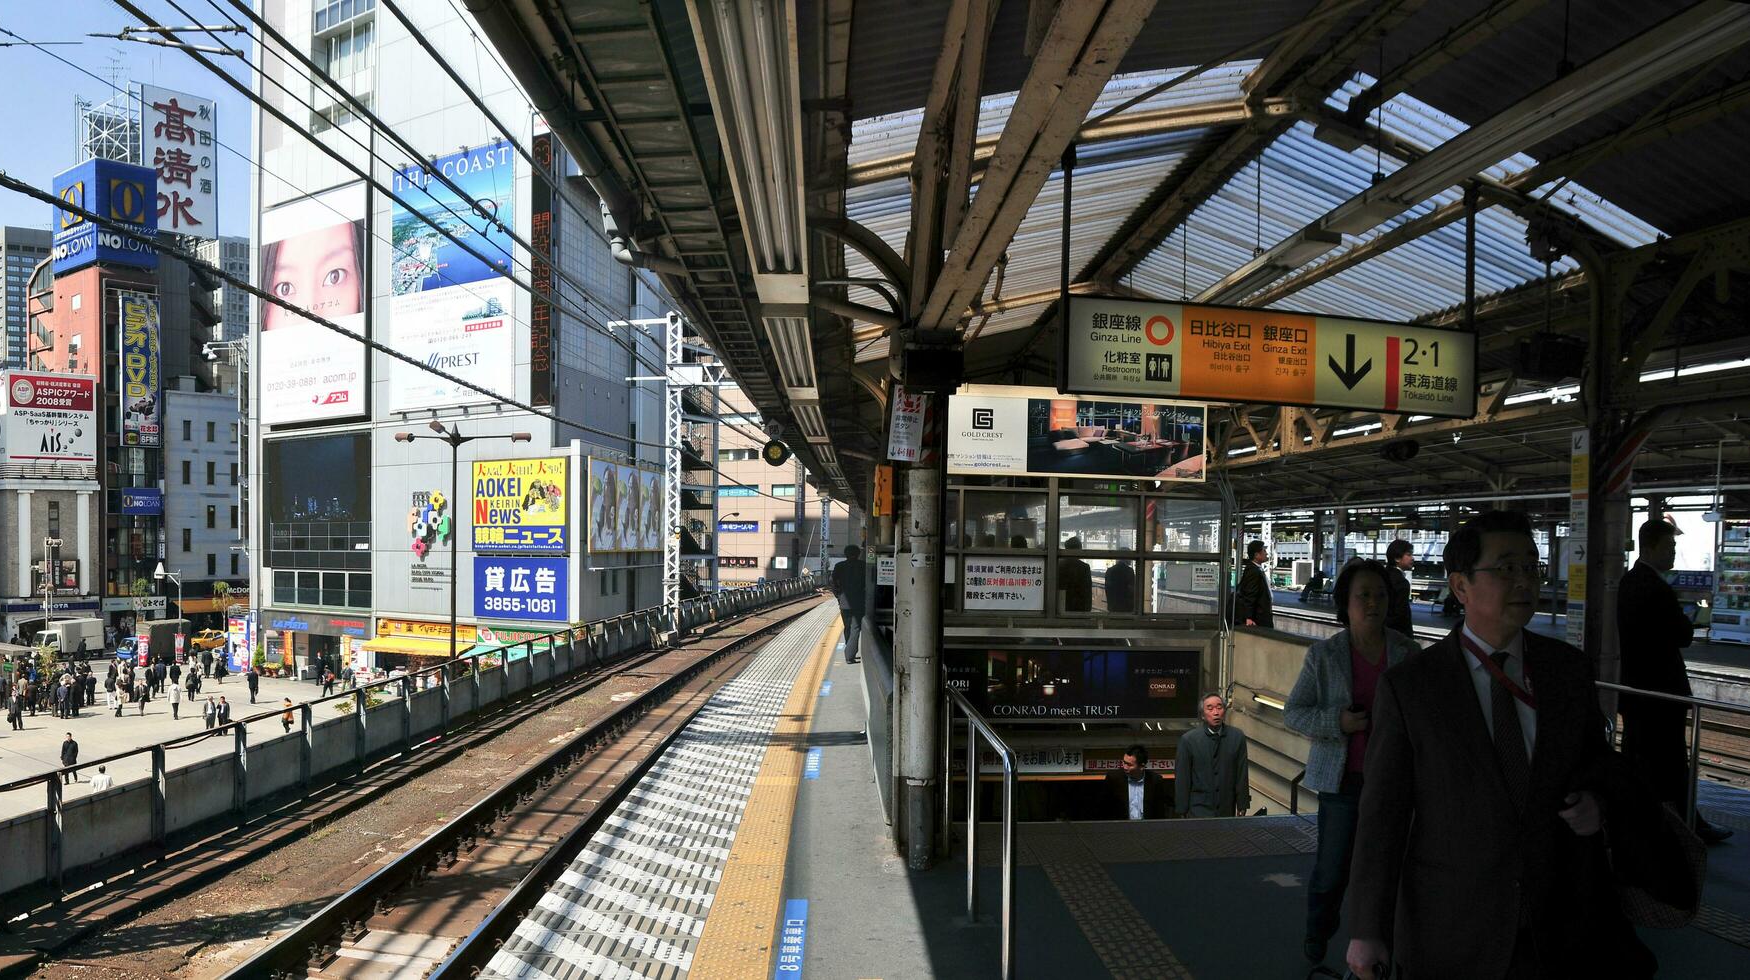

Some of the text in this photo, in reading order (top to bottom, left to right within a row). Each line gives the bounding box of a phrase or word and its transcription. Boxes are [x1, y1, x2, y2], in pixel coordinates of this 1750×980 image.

[198, 104, 213, 195] 秋田の酒
[442, 146, 510, 179] COAST
[1091, 312, 1142, 332] 銀座線
[1190, 319, 1251, 338] 日比谷口
[1090, 331, 1142, 343] Ginza Line
[1263, 324, 1308, 343] 銀座口
[1202, 338, 1251, 351] Hibiya Exit
[1262, 343, 1307, 355] Ginza Exit
[1104, 350, 1141, 364] 化粧室
[1213, 351, 1251, 362] 日比谷出口
[1101, 364, 1141, 374] Restrooms
[322, 370, 357, 385] acom.jp
[1403, 372, 1458, 392] 東海道線
[36, 387, 91, 399] ASPICアワード
[1437, 394, 1454, 403] Line
[36, 397, 73, 406] 2008受賞
[475, 477, 521, 498] AOKEI
[489, 499, 521, 508] KEIRIN
[475, 499, 521, 525] News
[474, 526, 564, 545] 競輪ニュース
[967, 565, 1042, 575] 横須賀線 ご利用のお客さまは
[484, 566, 557, 594] 貸広告
[965, 591, 1026, 600] 階段をご利用下さい。
[484, 596, 556, 613] 3855-1081
[993, 704, 1120, 716] CONRAD meets TRUST
